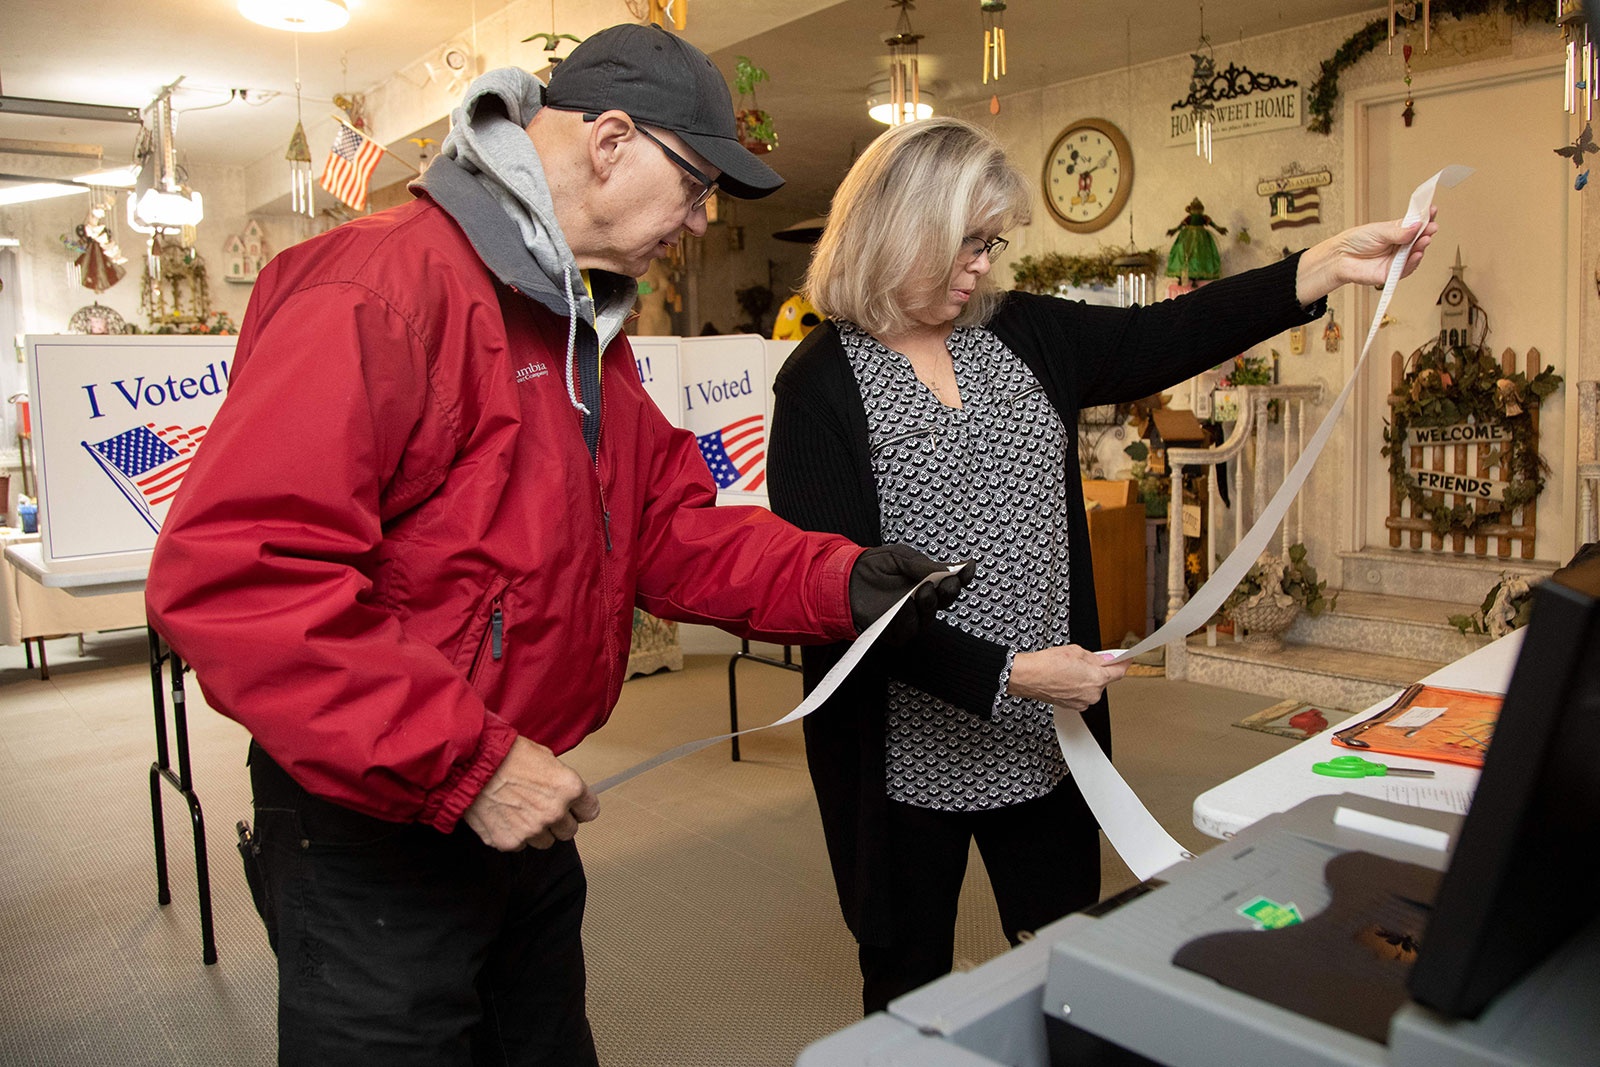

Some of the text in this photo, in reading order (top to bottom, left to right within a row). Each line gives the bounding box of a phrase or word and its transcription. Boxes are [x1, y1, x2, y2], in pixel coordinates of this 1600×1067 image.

[1208, 102, 1252, 125] SWEET
[1255, 94, 1295, 118] HOME
[81, 360, 229, 419] I Voted!
[684, 369, 752, 411] I Voted
[1416, 424, 1503, 443] WELCOME
[1418, 471, 1493, 497] FRIENDS
